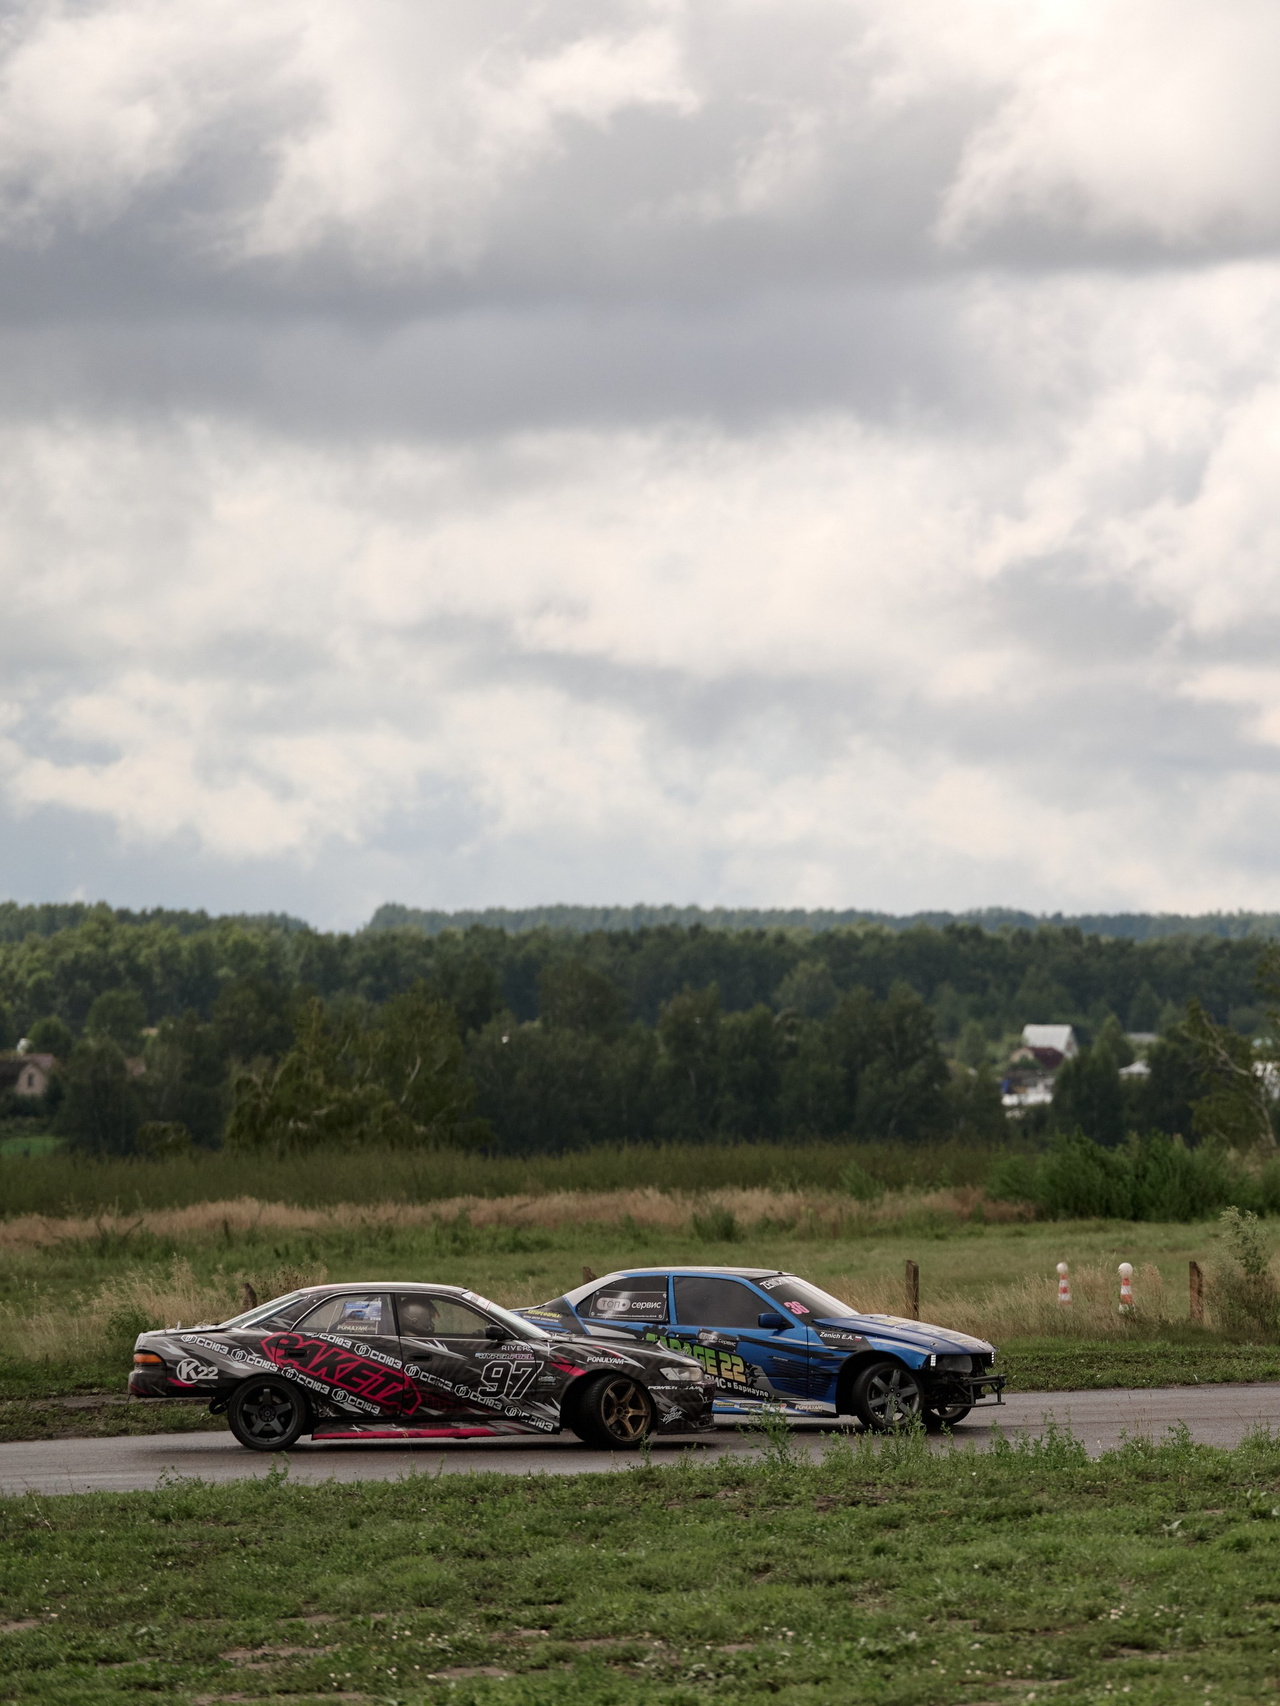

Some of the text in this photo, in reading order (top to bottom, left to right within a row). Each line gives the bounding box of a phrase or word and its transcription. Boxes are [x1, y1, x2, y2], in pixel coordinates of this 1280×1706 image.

[631, 1301, 662, 1310] сервис
[784, 1301, 810, 1315] 36
[820, 1331, 841, 1339] Zenich
[369, 1351, 402, 1370] СОЮЗ
[586, 1356, 625, 1365] PONULYAM
[719, 1351, 747, 1384] 22
[196, 1337, 381, 1415] СОЮЗ СОЮЗ СОЮЗ СОЮЗ
[477, 1360, 545, 1400] 97
[733, 1382, 770, 1398] Барнауле
